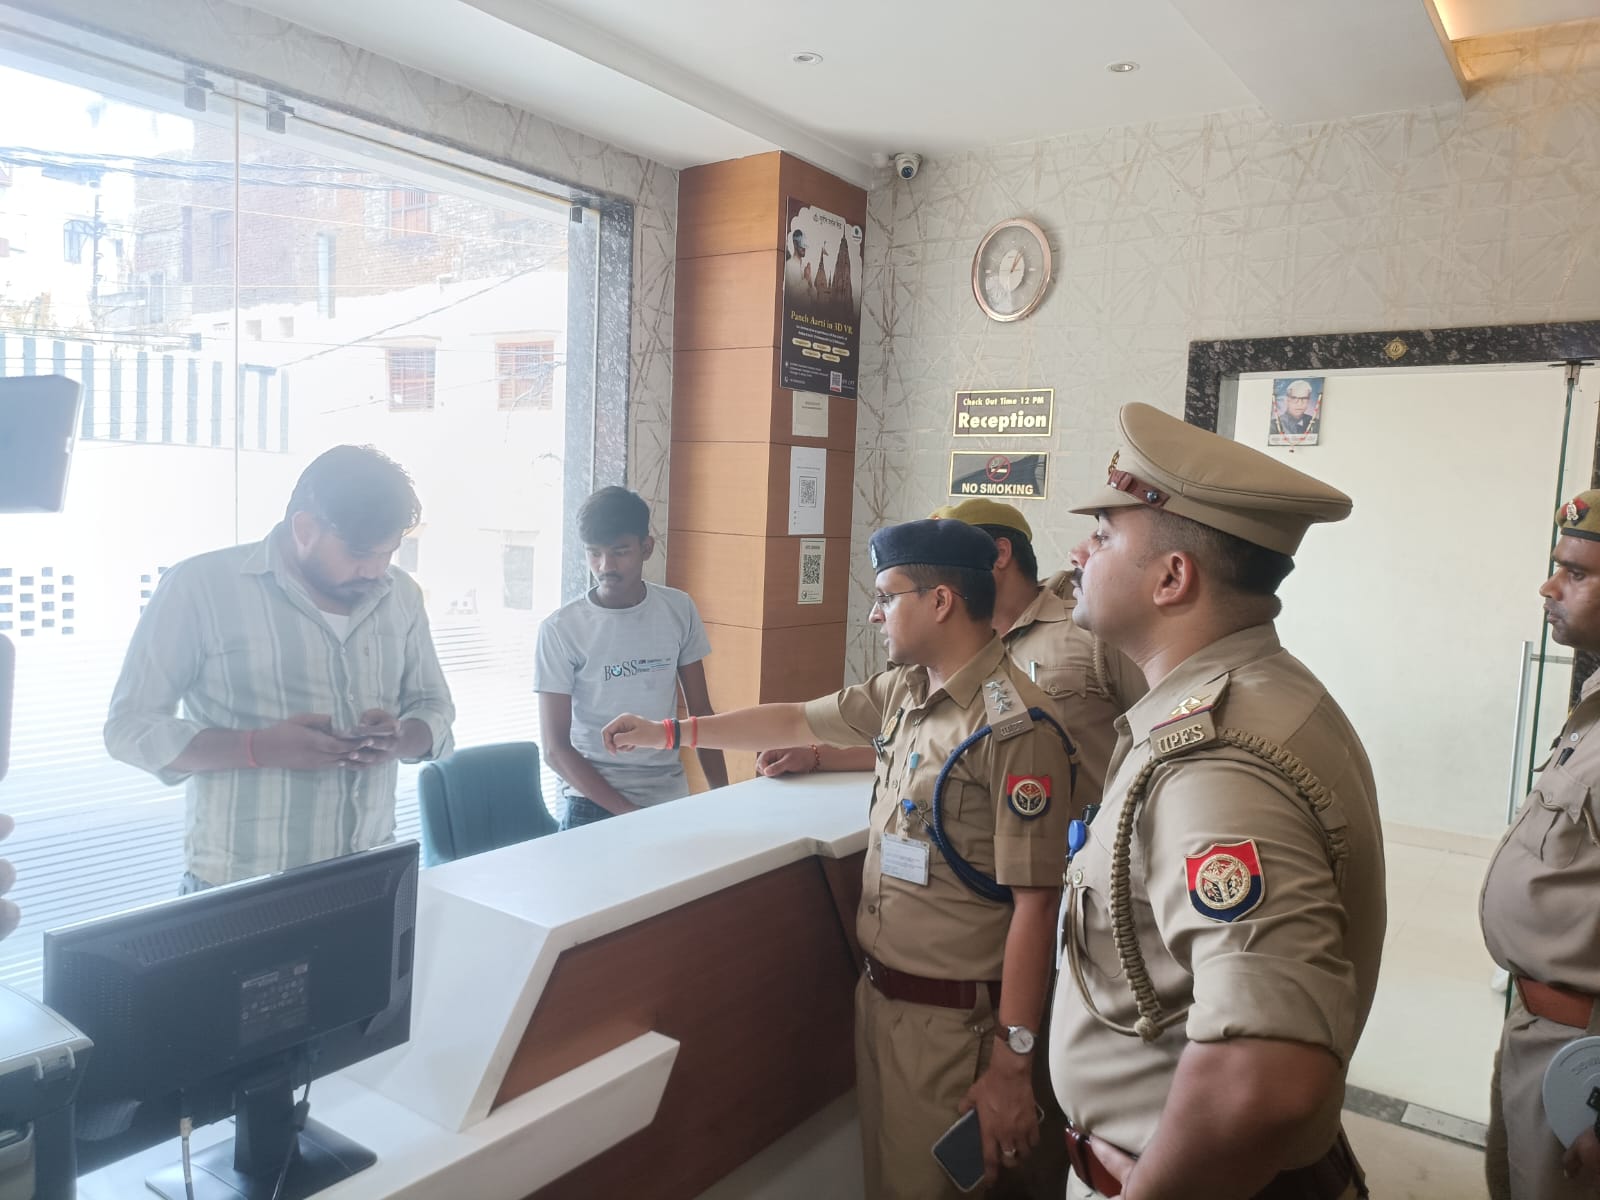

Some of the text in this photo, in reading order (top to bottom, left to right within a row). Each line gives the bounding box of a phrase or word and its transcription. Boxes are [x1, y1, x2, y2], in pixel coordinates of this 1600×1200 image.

[963, 398, 982, 406] Check
[985, 398, 997, 406] Out
[958, 410, 1047, 432] Reception
[961, 483, 1034, 495] NO SMOKING
